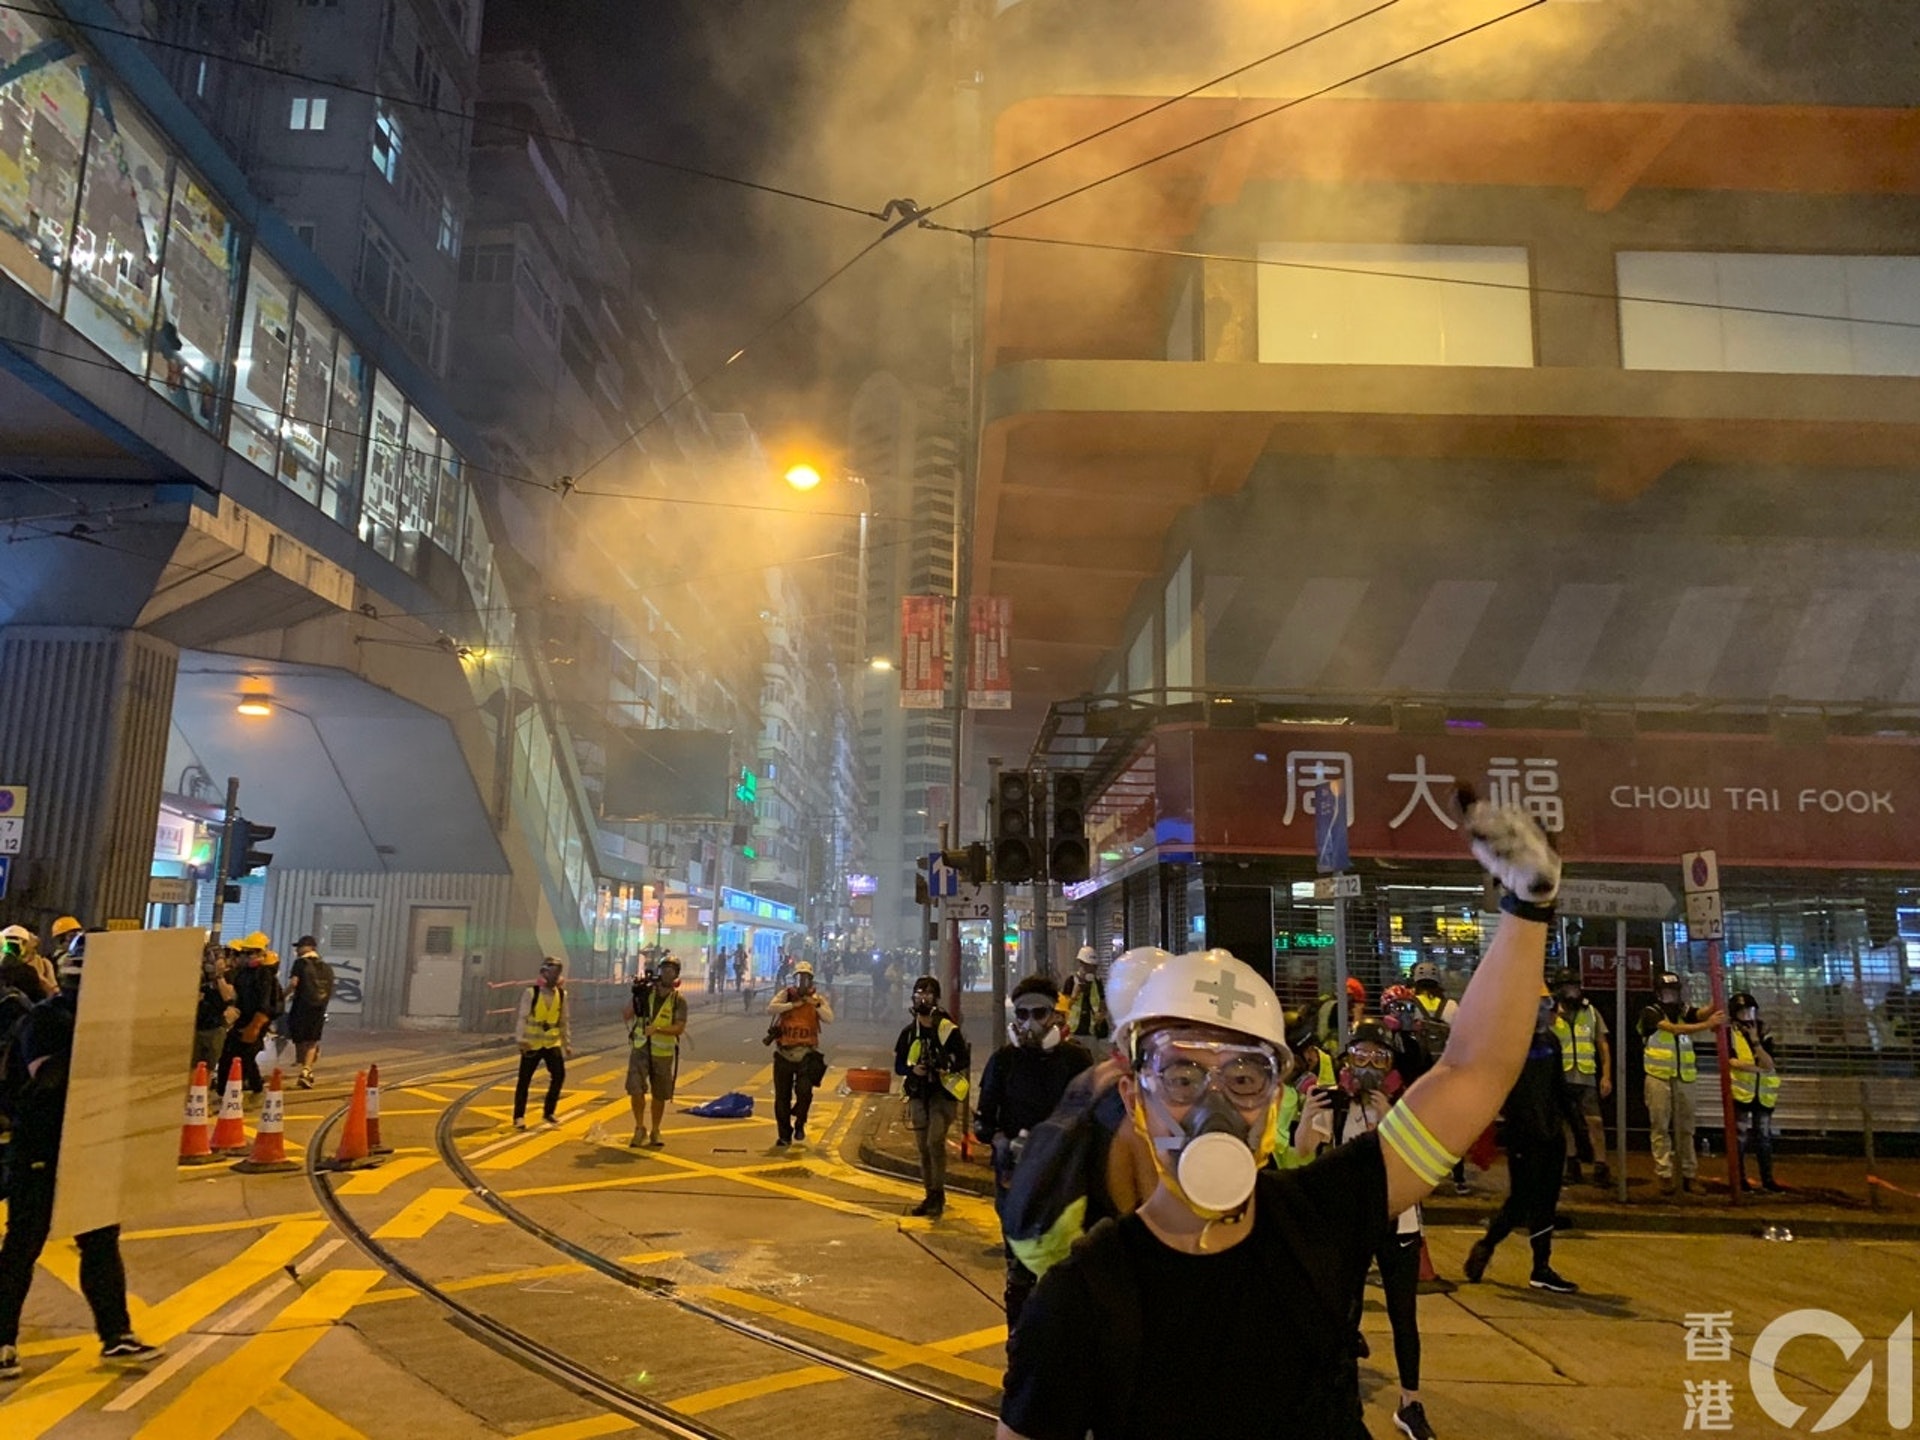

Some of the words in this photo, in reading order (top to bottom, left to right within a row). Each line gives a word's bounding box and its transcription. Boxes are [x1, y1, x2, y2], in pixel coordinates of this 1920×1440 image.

[1610, 785, 1711, 810] CHOW
[1723, 787, 1780, 811] TAI
[1797, 788, 1896, 814] FOOK
[5, 838, 18, 851] 12
[1344, 878, 1358, 893] 12
[1598, 883, 1629, 895] Road
[974, 904, 990, 916] 12
[1706, 896, 1713, 910] 7
[1709, 919, 1720, 933] 12
